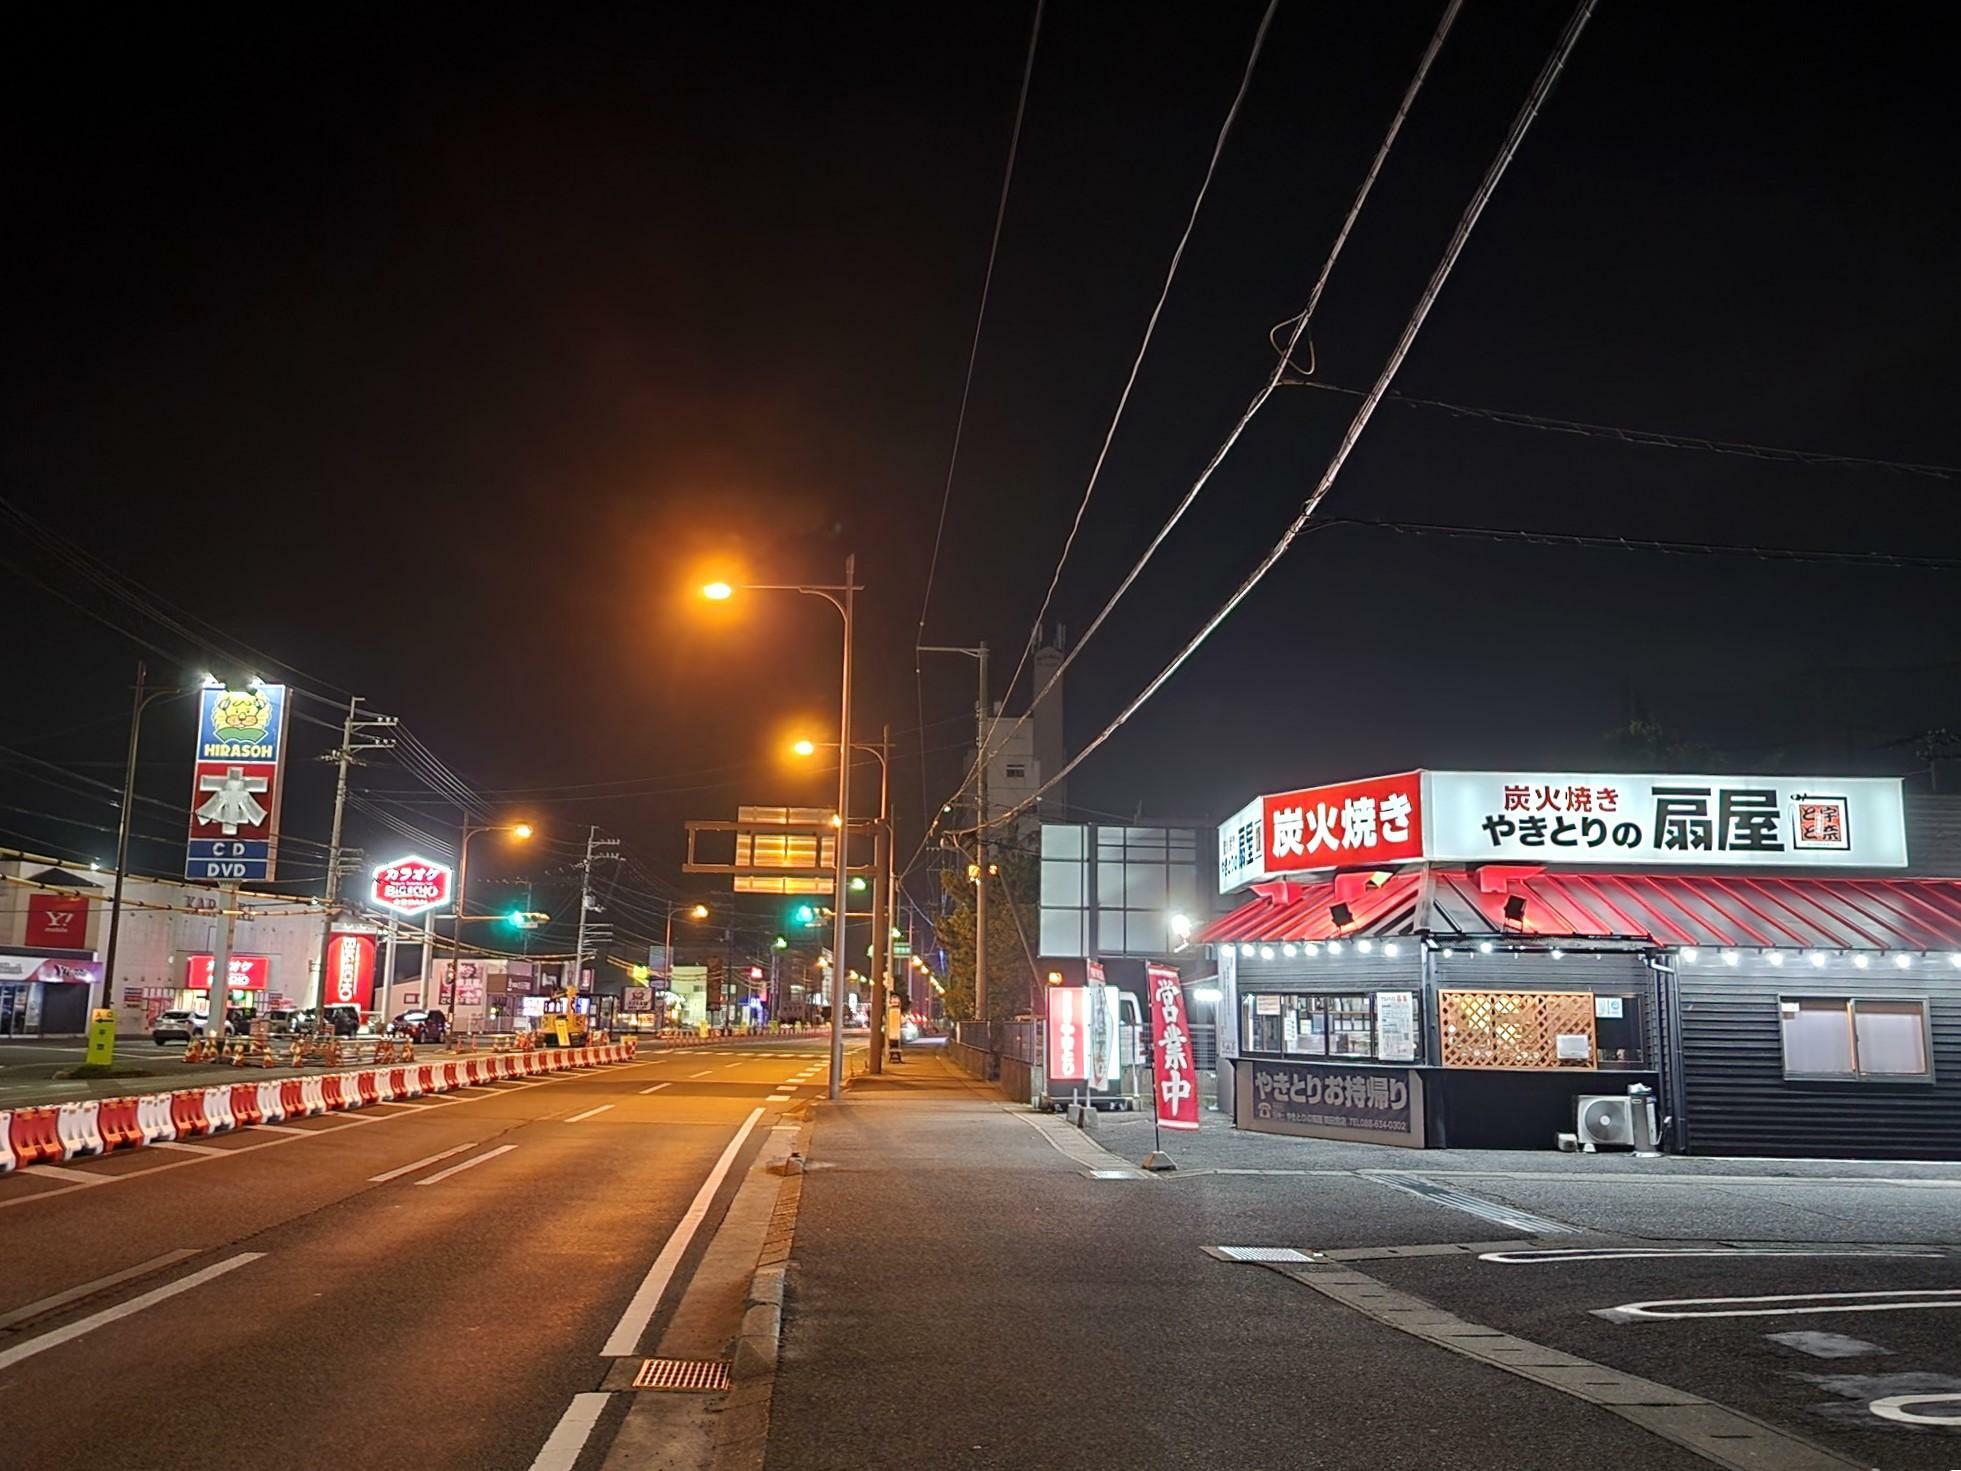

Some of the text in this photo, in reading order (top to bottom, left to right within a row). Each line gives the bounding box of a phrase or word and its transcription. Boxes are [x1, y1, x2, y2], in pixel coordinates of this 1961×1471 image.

[203, 743, 273, 758] HIRASOH
[1504, 785, 1619, 812] 炭火焼き
[1271, 792, 1412, 858] 炭火焼き
[1481, 814, 1643, 849] やきとりの
[1651, 786, 1785, 852] 扇屋
[206, 862, 247, 877] DVD
[1155, 979, 1192, 1117] 営業中
[1255, 1071, 1407, 1110] やきとりお持帰り
